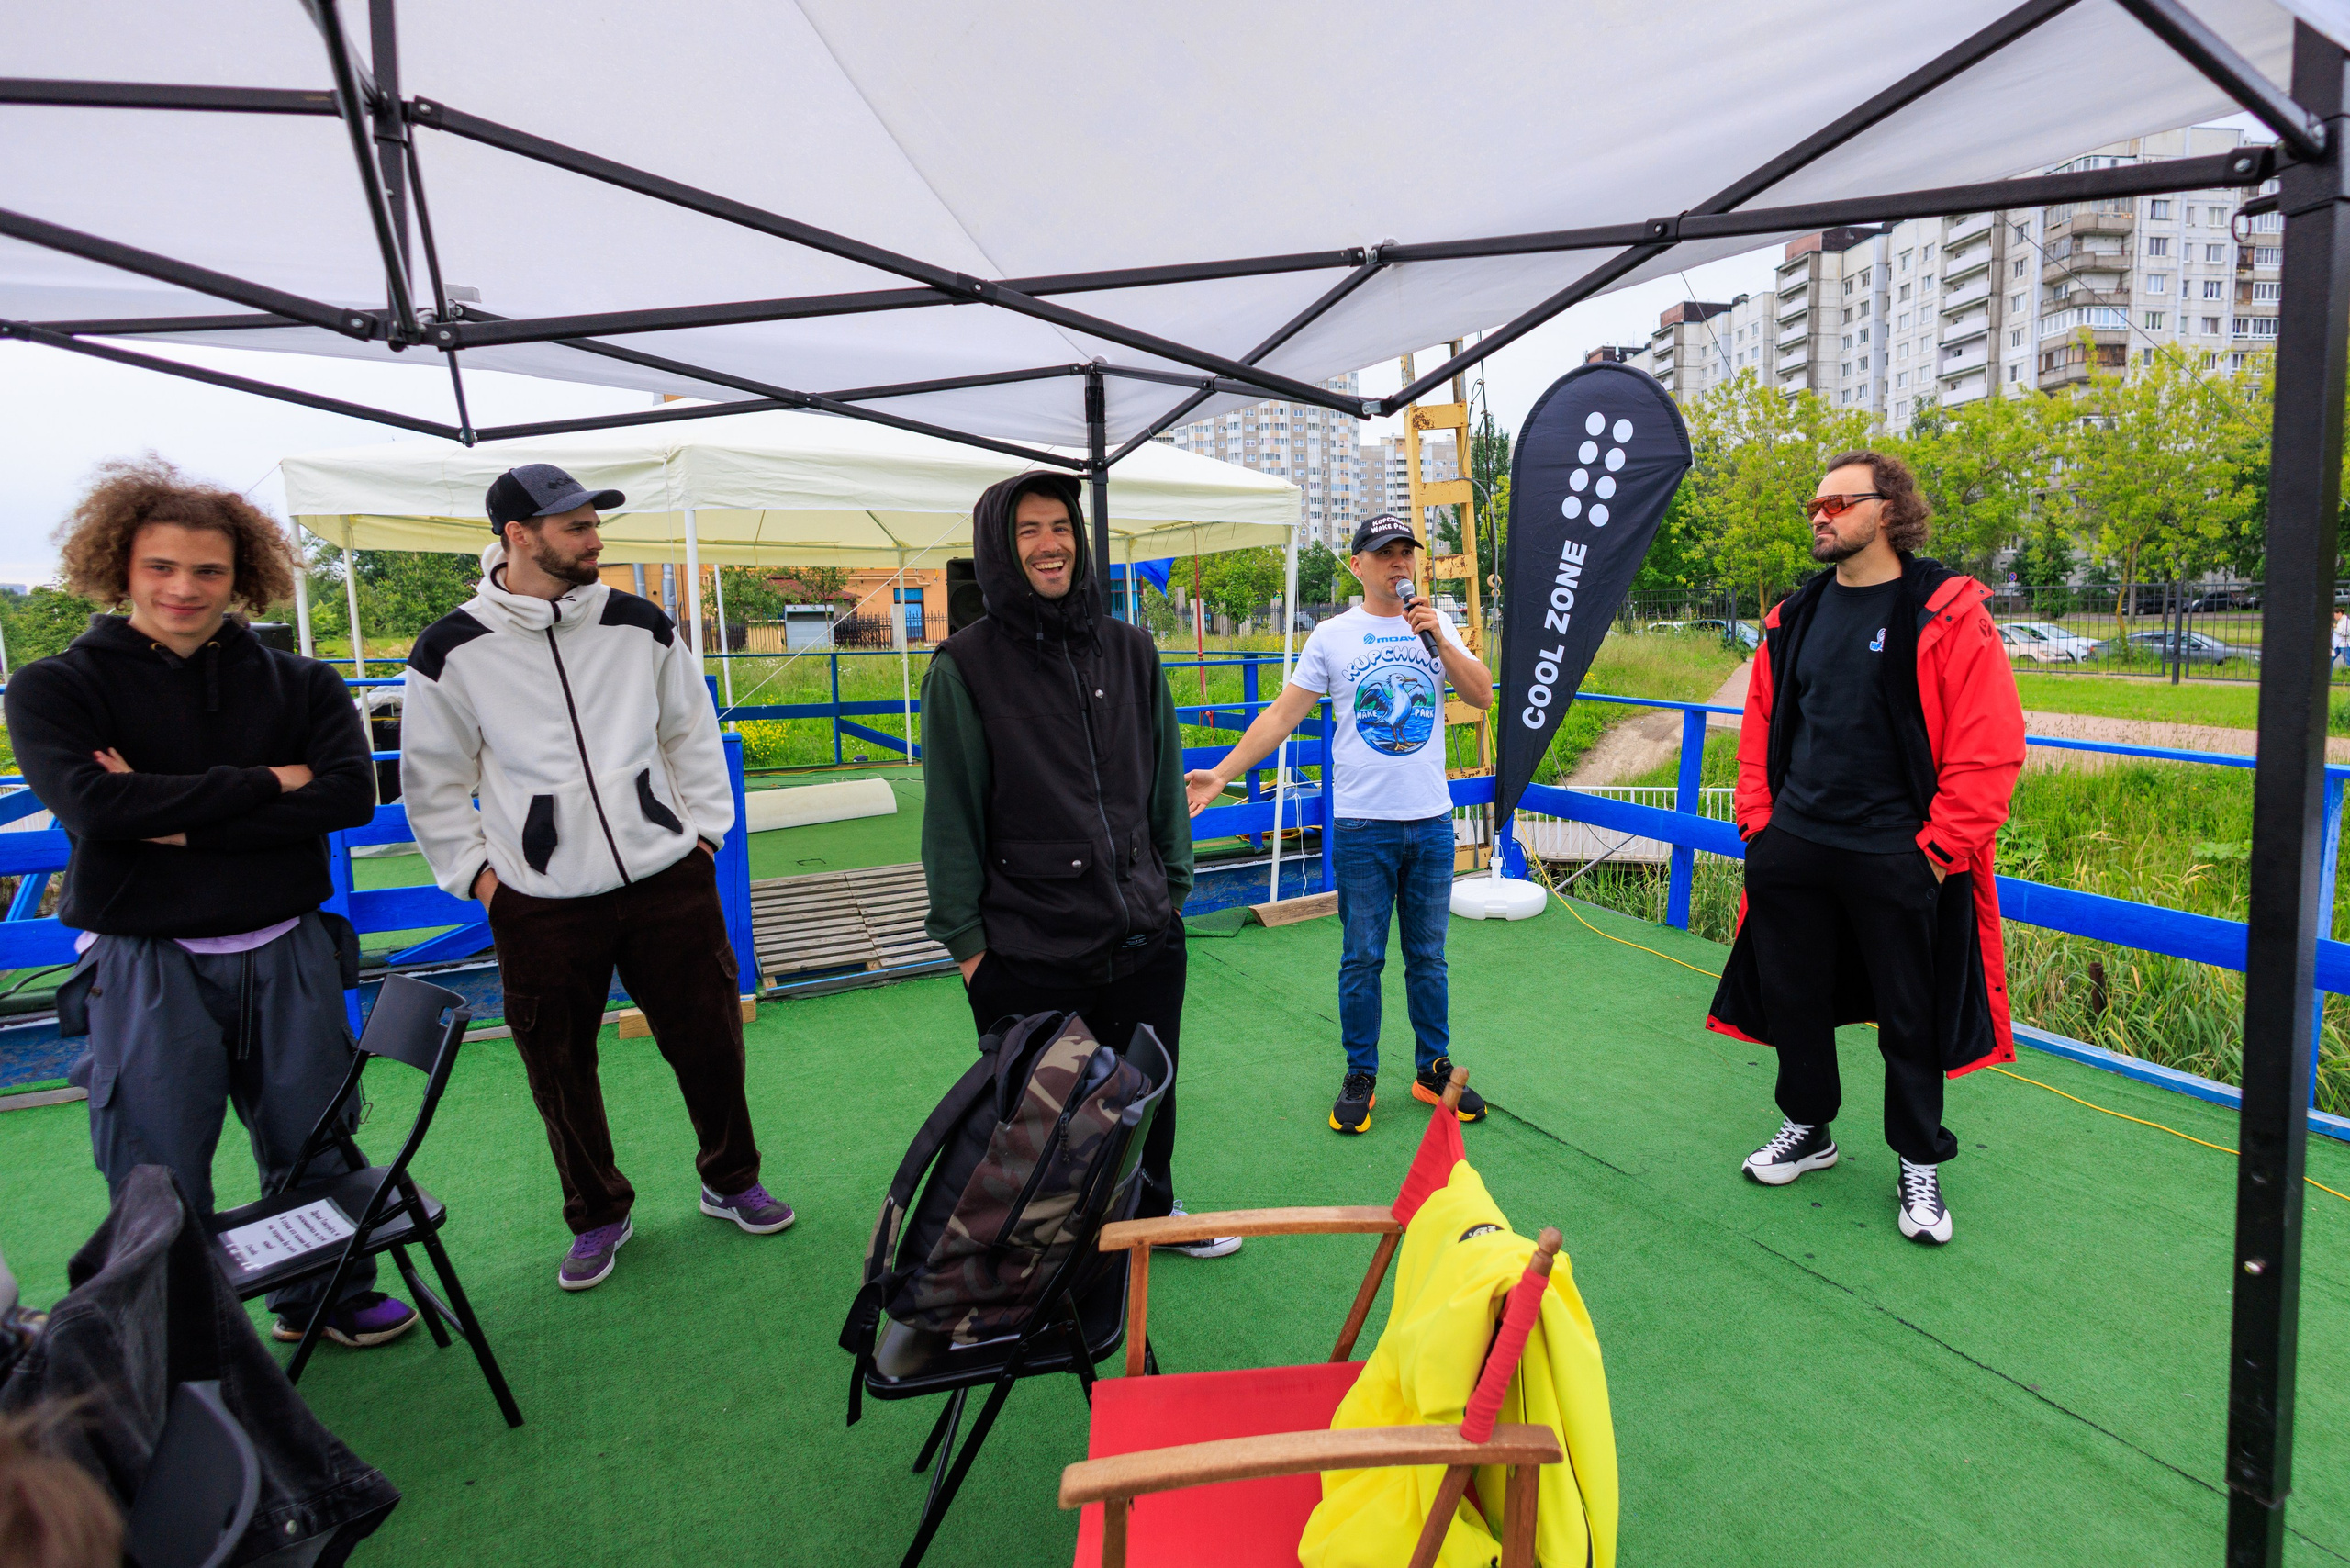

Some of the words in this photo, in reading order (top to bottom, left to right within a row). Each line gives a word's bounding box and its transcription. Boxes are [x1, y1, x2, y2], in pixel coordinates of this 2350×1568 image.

[1371, 523, 1392, 533] WAKE
[1522, 644, 1565, 730] COOL
[1544, 540, 1587, 634] ZONE
[1342, 645, 1442, 682] KUPCHINO
[1357, 710, 1378, 721] WAKE
[1415, 708, 1434, 718] PARK
